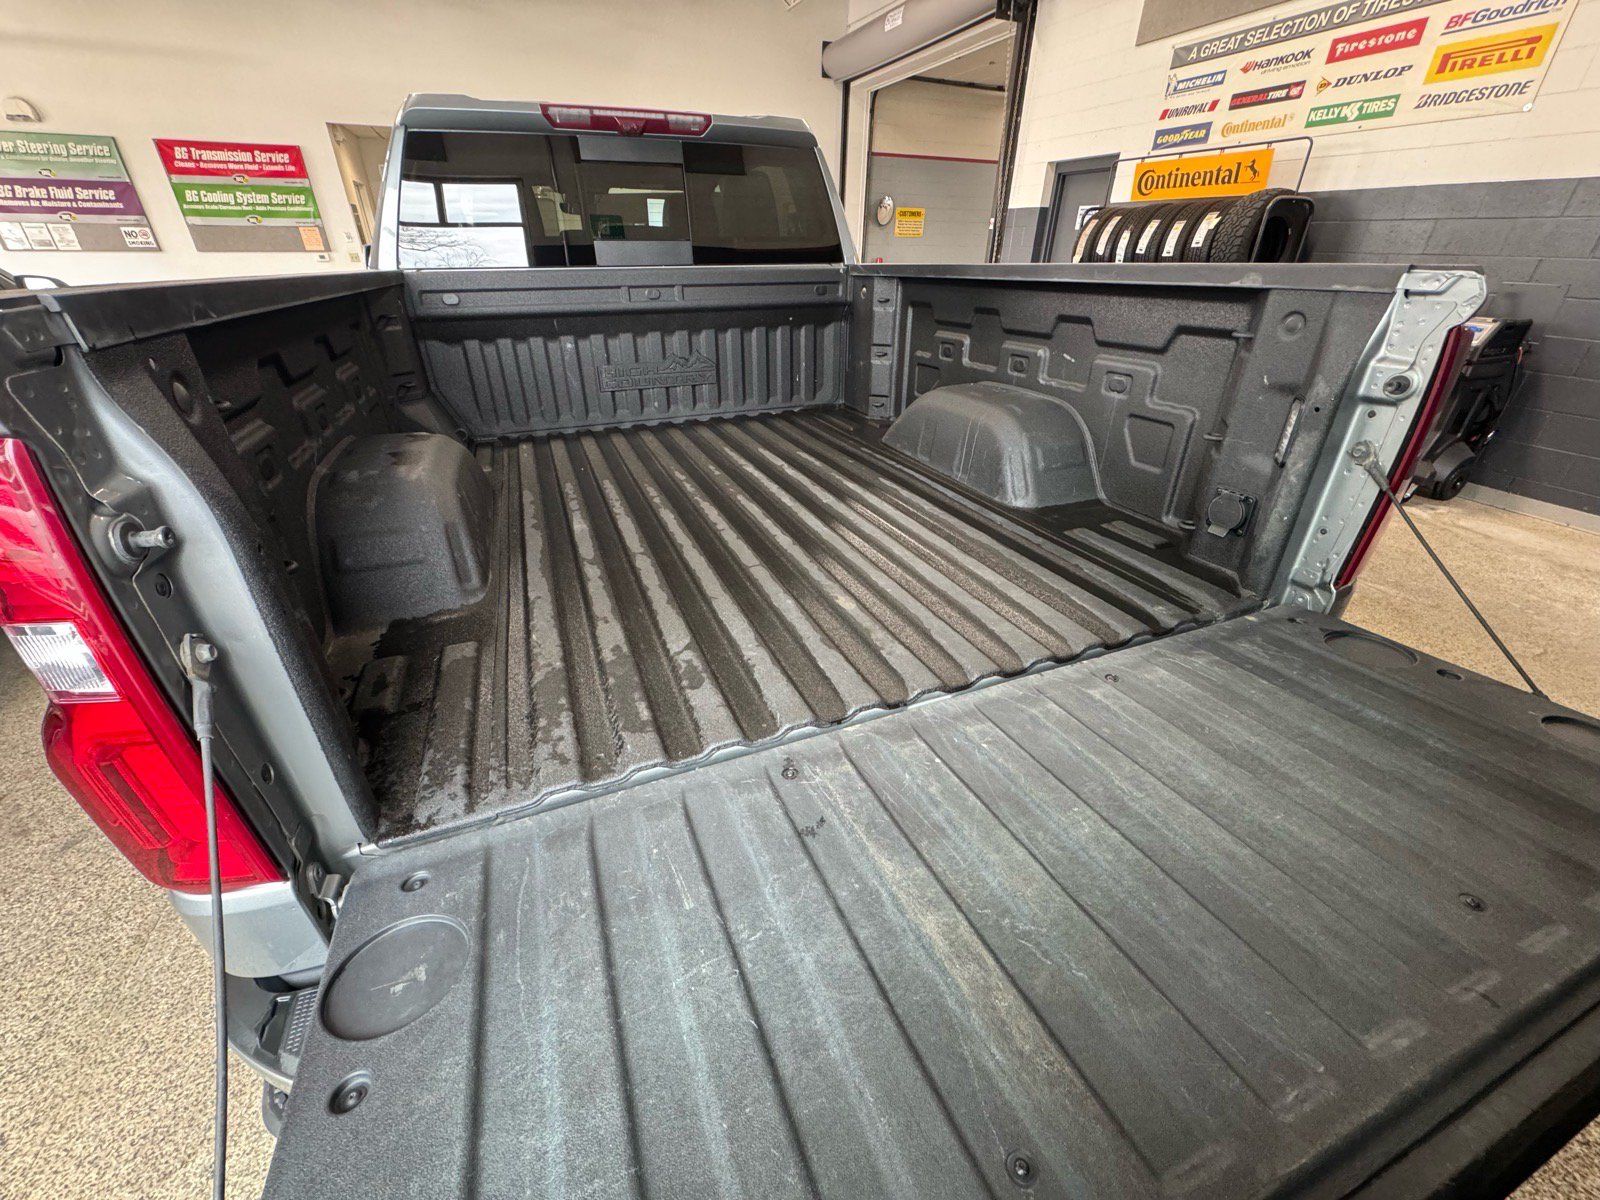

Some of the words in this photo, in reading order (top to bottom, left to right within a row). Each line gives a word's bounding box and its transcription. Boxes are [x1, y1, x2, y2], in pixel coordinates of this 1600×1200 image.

[1187, 46, 1198, 61] A
[1199, 34, 1245, 57] GREAT
[1244, 11, 1331, 46] SELECTION
[1332, 0, 1360, 24] OF
[1334, 27, 1417, 58] Firestone
[1434, 35, 1543, 75] PIRELLI
[1176, 73, 1224, 90] MICHELIN
[1332, 64, 1414, 88] DUNLOP
[1413, 79, 1535, 109] BRIDGESTONE
[1167, 102, 1210, 119] UNIROYAL
[1308, 105, 1342, 122] KELLY
[1361, 98, 1397, 114] TIRES
[1156, 128, 1207, 144] GOODYEAR
[1221, 113, 1288, 138] Continental
[16, 139, 68, 157] Steering
[68, 142, 111, 157] Service
[174, 147, 189, 160] BG
[190, 148, 252, 163] Transmission
[255, 150, 290, 163] Service
[1137, 161, 1243, 196] Continental
[14, 185, 48, 199] Brake
[48, 186, 75, 200] Fluid
[75, 187, 116, 201] Service
[184, 190, 199, 202] BG
[200, 190, 235, 205] Cooling
[236, 191, 270, 206] System
[271, 192, 306, 205] Service
[123, 230, 138, 239] NO
